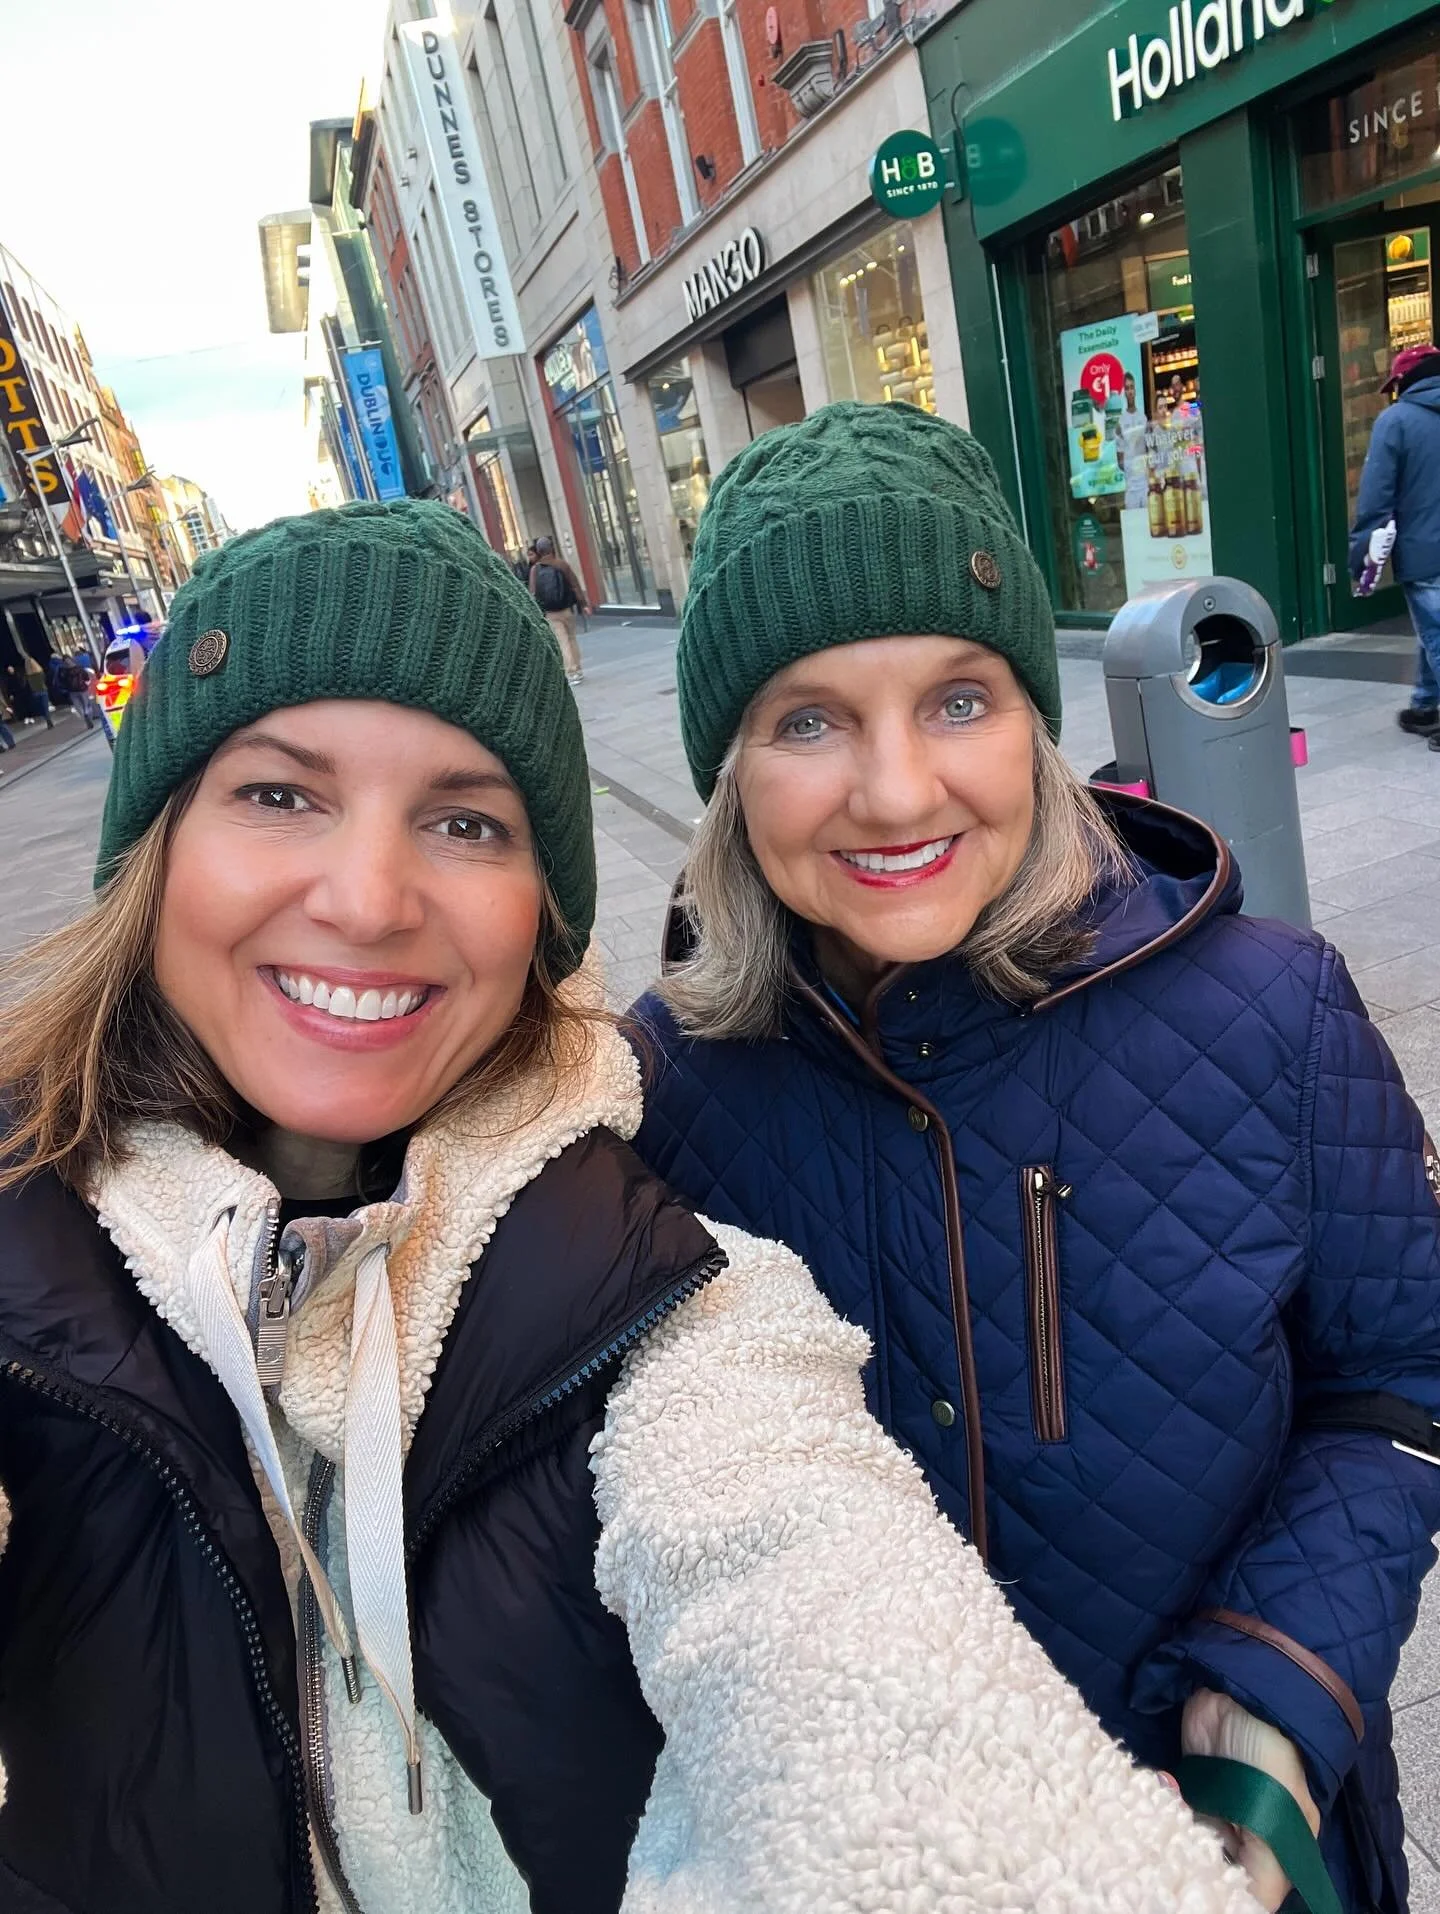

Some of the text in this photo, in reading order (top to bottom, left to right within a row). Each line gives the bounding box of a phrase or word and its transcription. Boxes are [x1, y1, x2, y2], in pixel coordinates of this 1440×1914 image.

[1349, 90, 1423, 143] SINCE
[421, 30, 509, 347] DUNNES STORES
[886, 184, 915, 198] SINCE
[682, 227, 763, 323] MANGO
[1078, 325, 1117, 341] The Daily
